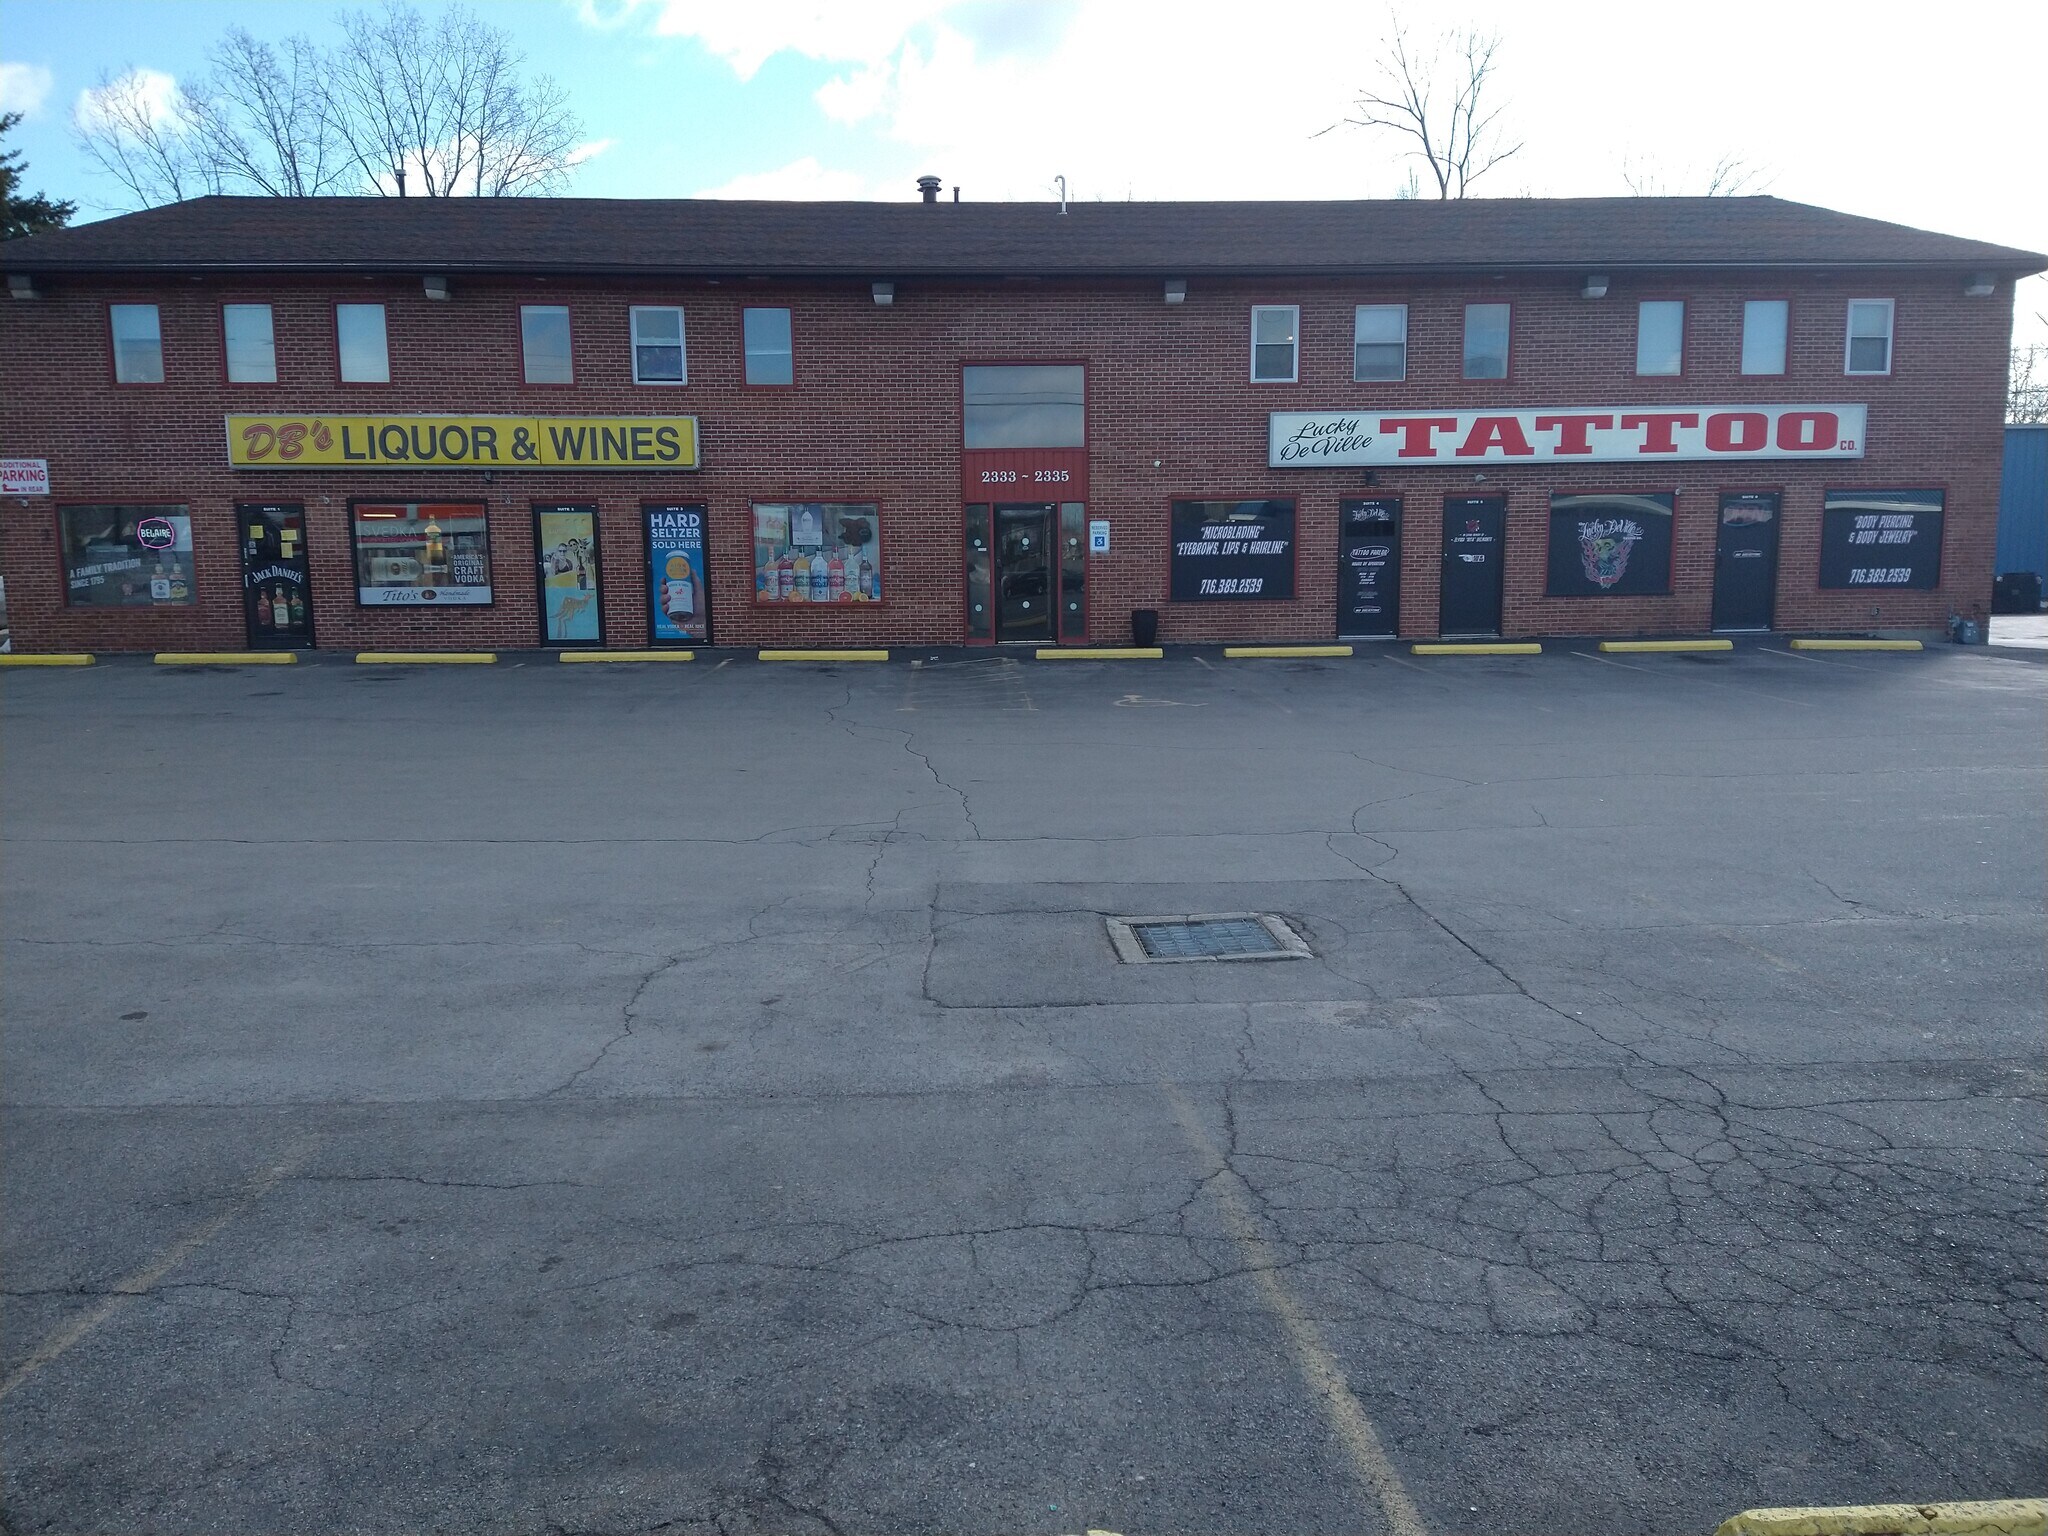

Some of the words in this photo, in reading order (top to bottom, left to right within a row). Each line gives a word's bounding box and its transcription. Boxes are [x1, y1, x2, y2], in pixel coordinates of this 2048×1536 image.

[1288, 417, 1360, 442] Lucky
[1380, 412, 1839, 457] TATTOO
[1840, 440, 1857, 451] CO.
[242, 420, 334, 461] DB's
[341, 425, 499, 461] LIQUOR
[511, 426, 540, 461] &
[548, 426, 681, 461] WINES
[981, 470, 1017, 483] 2333
[1034, 470, 1069, 482] 2335
[650, 514, 700, 527] HARD
[1878, 515, 1914, 528] PIERCING
[141, 529, 171, 538] BELAIRE
[362, 525, 418, 537] SVEDKA
[651, 528, 701, 538] SELTZER
[1848, 533, 1855, 543] &
[1855, 531, 1877, 544] BODY
[652, 541, 676, 549] SOLD
[678, 541, 702, 549] HERE
[1221, 542, 1239, 556] LIPS
[1241, 542, 1248, 554] &
[70, 569, 75, 579] A
[76, 563, 102, 578] FAMILY
[102, 558, 141, 573] TRADITION
[252, 568, 271, 584] JACK
[271, 565, 304, 585] DANIEL'S
[454, 566, 484, 575] CRAFT
[71, 579, 90, 589] SINCE
[90, 576, 105, 586] 1795
[454, 575, 485, 583] VODKA
[1848, 568, 1912, 584] 716.389.2539
[1199, 578, 1263, 594] 716.389.2539
[382, 590, 419, 602] Tito's
